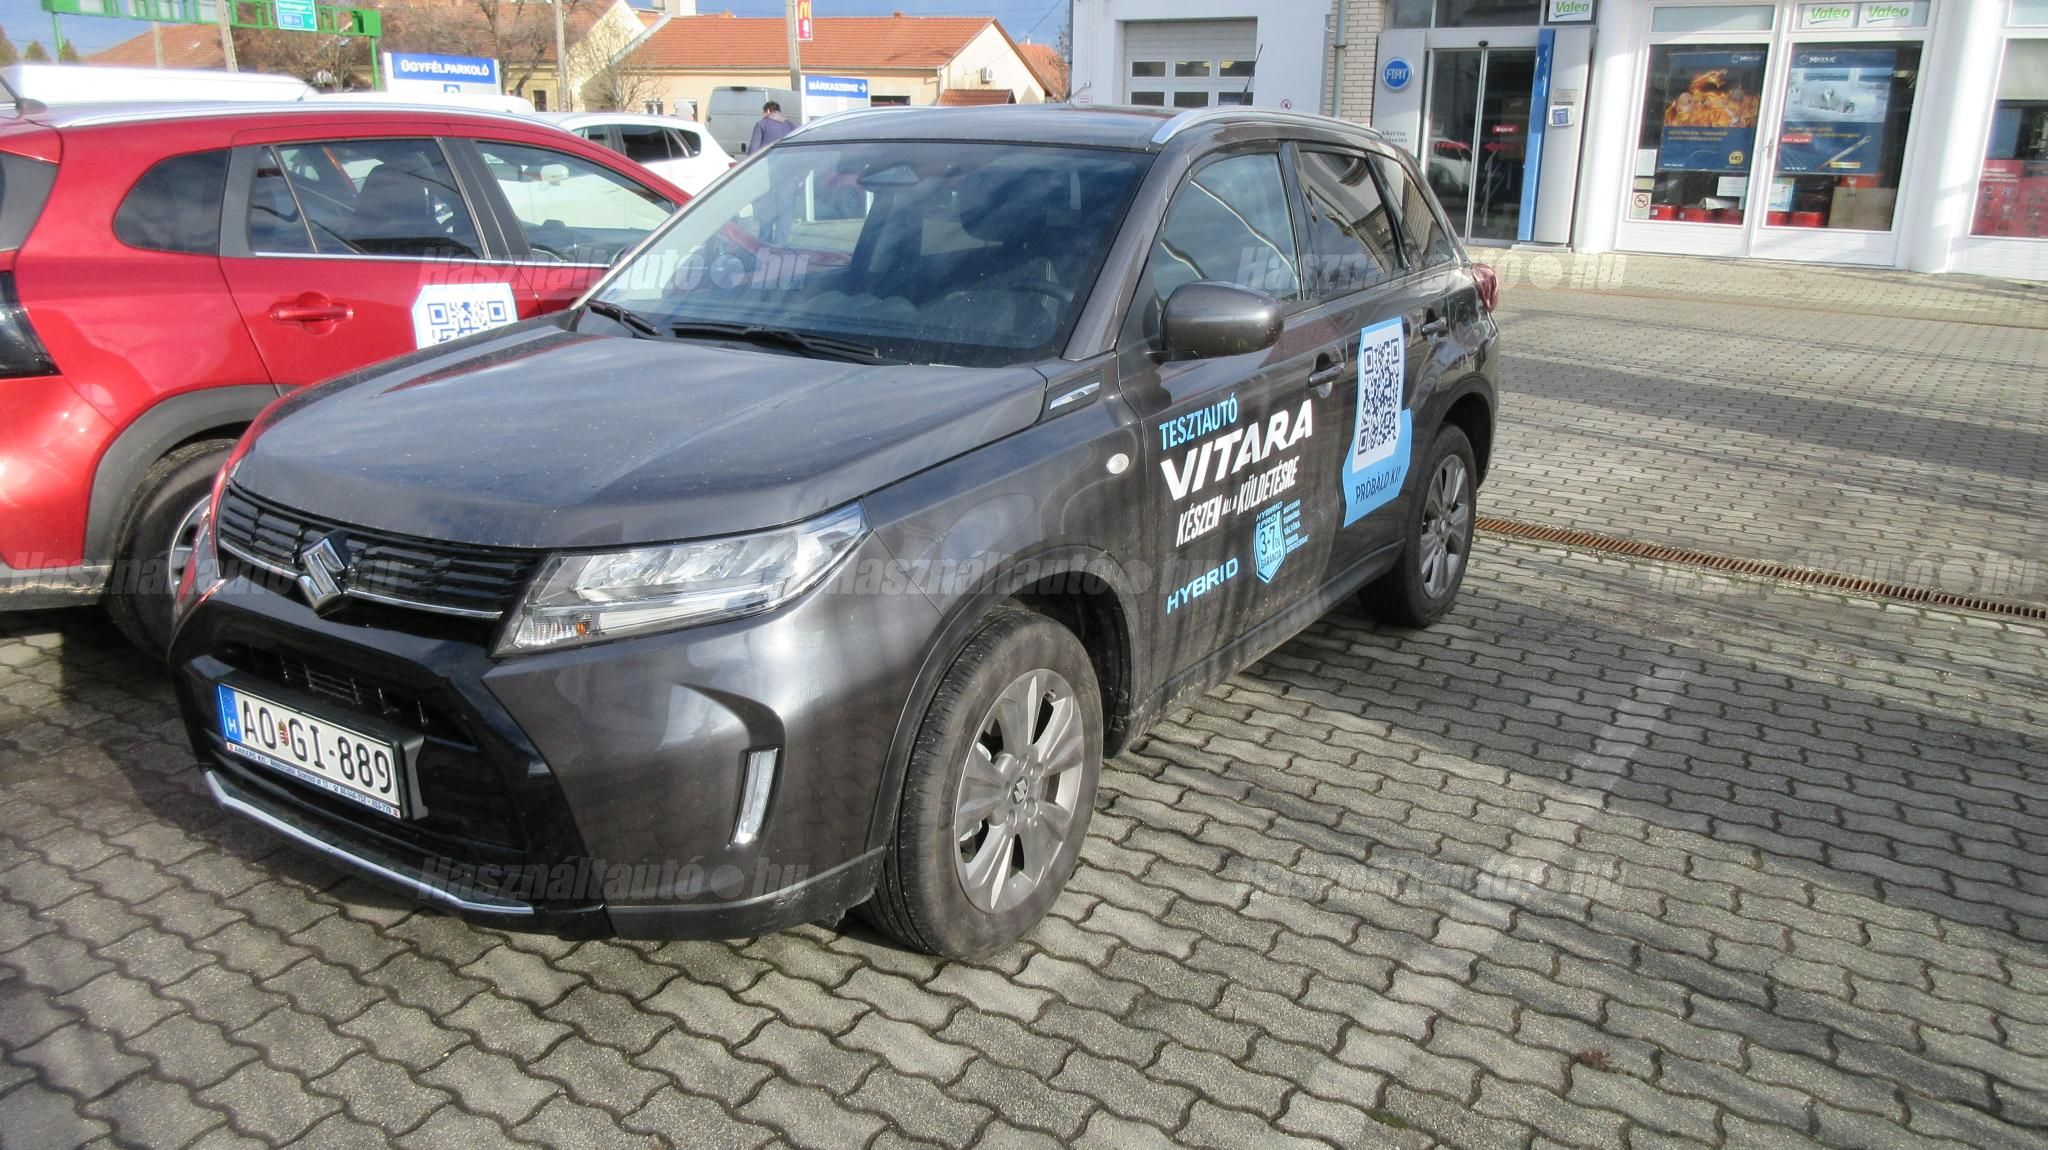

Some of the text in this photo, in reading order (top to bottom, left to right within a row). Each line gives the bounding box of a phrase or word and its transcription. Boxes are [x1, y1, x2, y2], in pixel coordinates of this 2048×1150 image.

[1555, 0, 1589, 12] Valeo
[1811, 7, 1850, 19] Valeo
[1869, 6, 1910, 18] Valeo
[401, 59, 490, 77] ÜGYFÉLPARKOLÓ
[1385, 68, 1408, 80] FIAT
[1159, 392, 1238, 450] TESZTAUTÓ
[1160, 399, 1313, 501] VITARA
[1355, 471, 1390, 504] PRÓBÁLD
[1176, 494, 1223, 547] KÉSZEN
[1237, 456, 1300, 516] KÜLDETÉSRE
[1256, 501, 1283, 521] HYBRID
[1260, 513, 1277, 528] PRO
[1166, 557, 1239, 615] HYBRID
[227, 719, 238, 734] H
